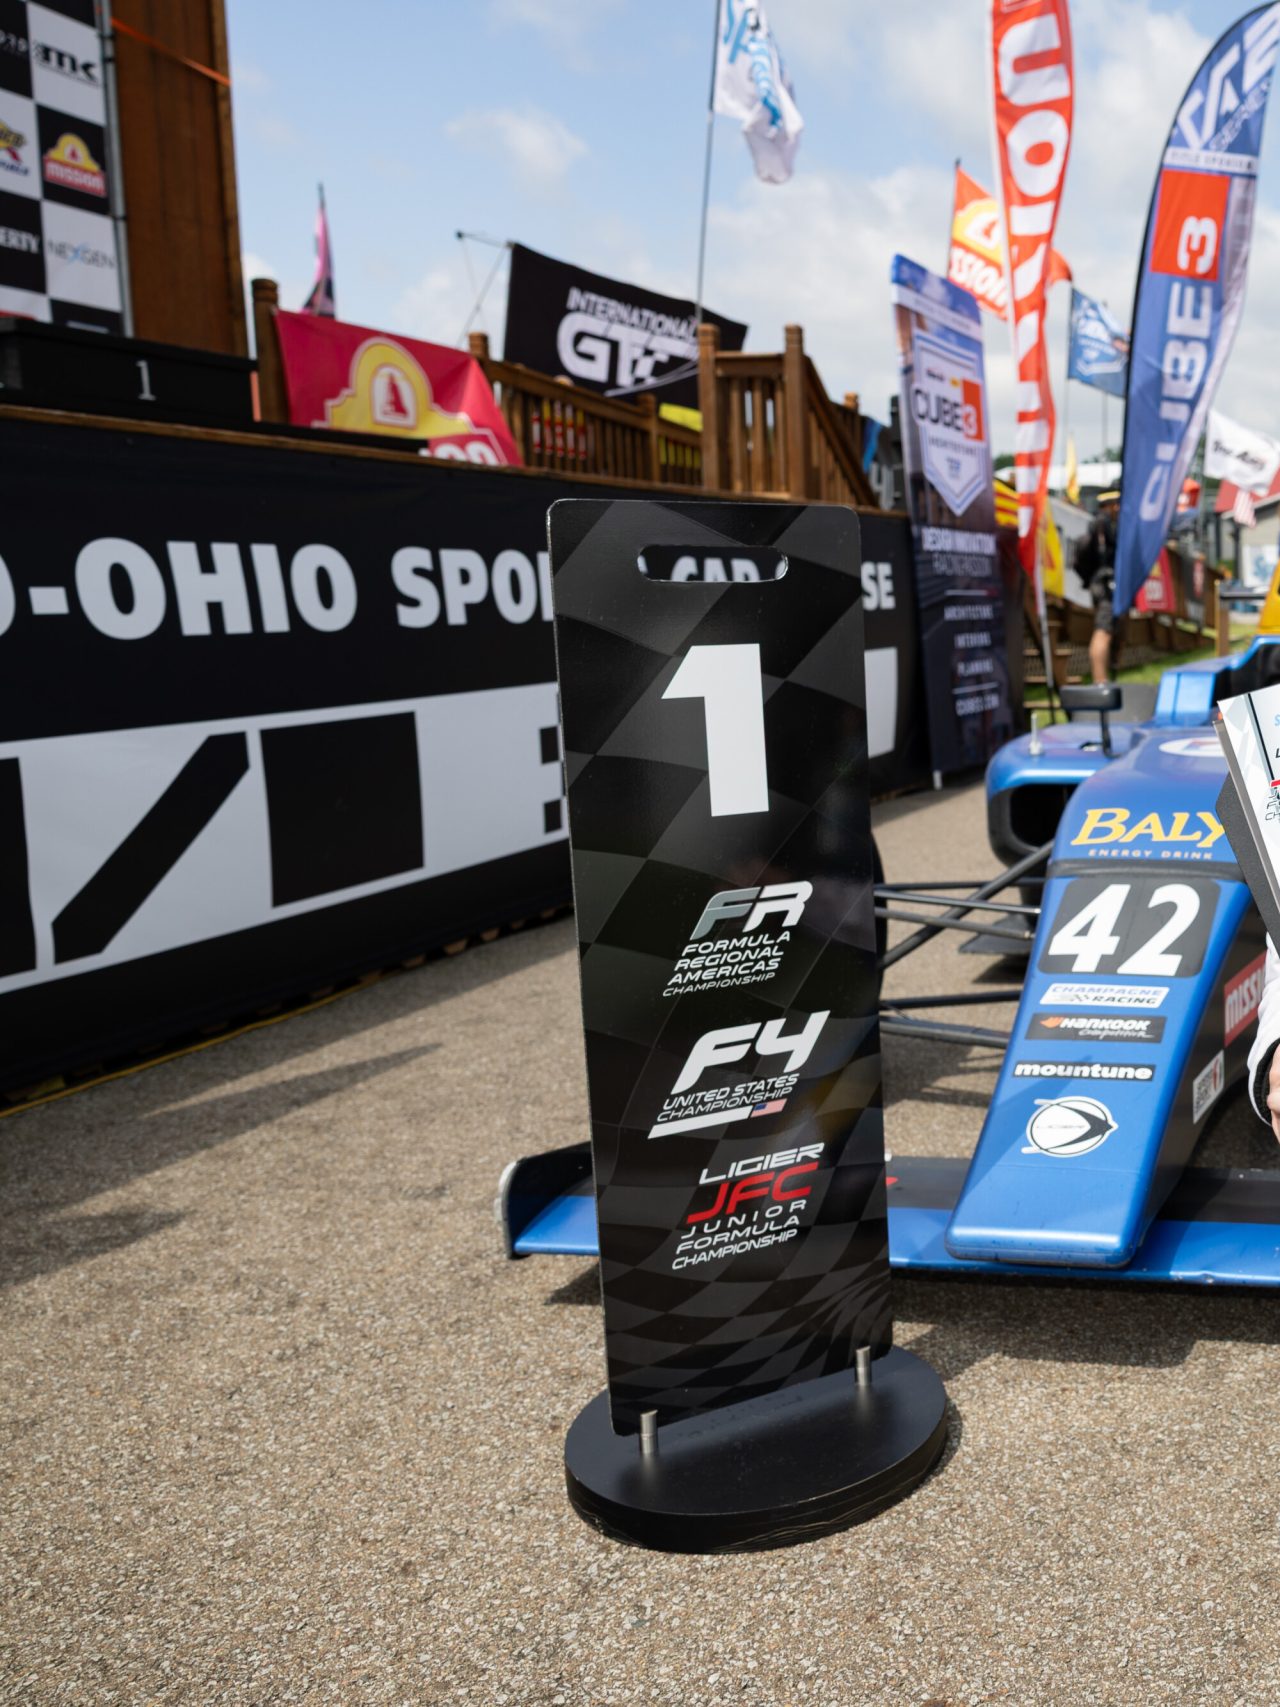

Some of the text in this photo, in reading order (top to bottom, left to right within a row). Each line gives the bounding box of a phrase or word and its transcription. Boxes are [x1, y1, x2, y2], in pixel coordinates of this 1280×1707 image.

[566, 286, 698, 341] INTERNATIONAL
[661, 643, 770, 817] 1
[1088, 848, 1213, 860] ENERGY DRINK
[690, 880, 814, 941] FR
[1048, 883, 1201, 977] 42
[674, 945, 785, 972] REGIONAL
[681, 930, 791, 957] FORMULA
[662, 972, 776, 997] CHAMPIONSHIP
[667, 958, 781, 987] AMERICAS
[1051, 985, 1162, 997] CHAMPAGNE
[1092, 994, 1156, 1005] RACING
[671, 1010, 831, 1095] F4
[1014, 1063, 1153, 1080] mountune
[657, 1086, 793, 1122] CHAMPIONSHIP
[663, 1072, 800, 1111] UNITED STATES
[698, 1142, 825, 1185] LIGIER
[686, 1161, 819, 1224] JFC
[675, 1214, 801, 1255] FORMULA
[681, 1199, 807, 1240] JUNIOR
[672, 1228, 798, 1270] CHAMPIONSHIP
